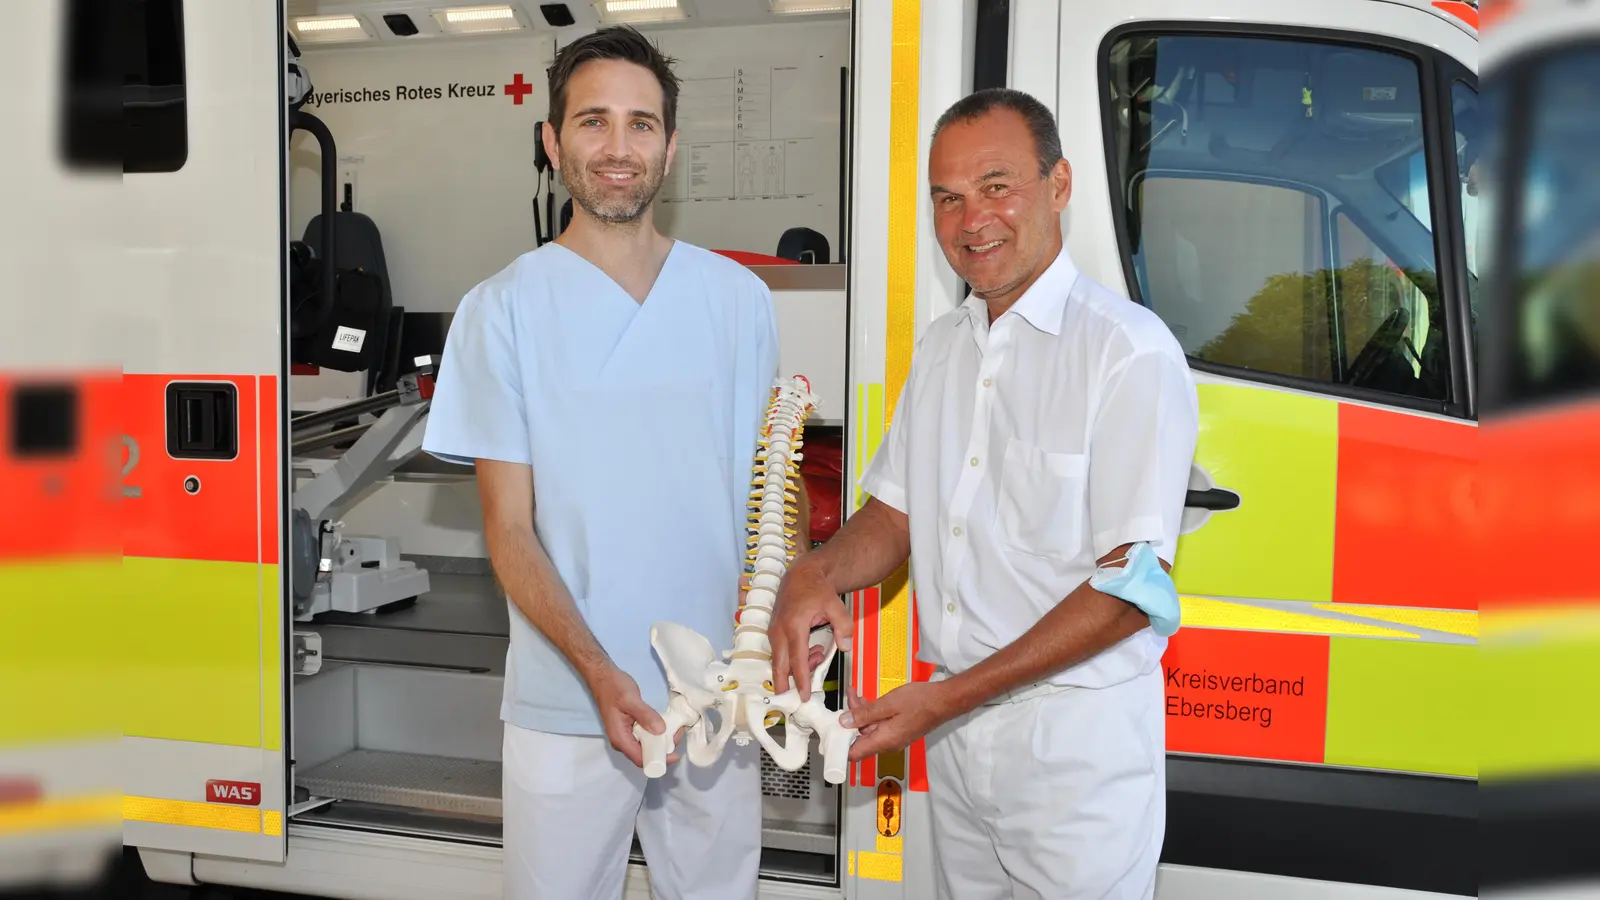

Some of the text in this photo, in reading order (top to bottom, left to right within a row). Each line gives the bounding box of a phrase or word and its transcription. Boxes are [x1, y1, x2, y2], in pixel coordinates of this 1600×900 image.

[305, 83, 495, 108] ayerisches Rotes Kreuz
[1166, 667, 1304, 696] Kreisverband
[1165, 695, 1272, 728] Ebersberg
